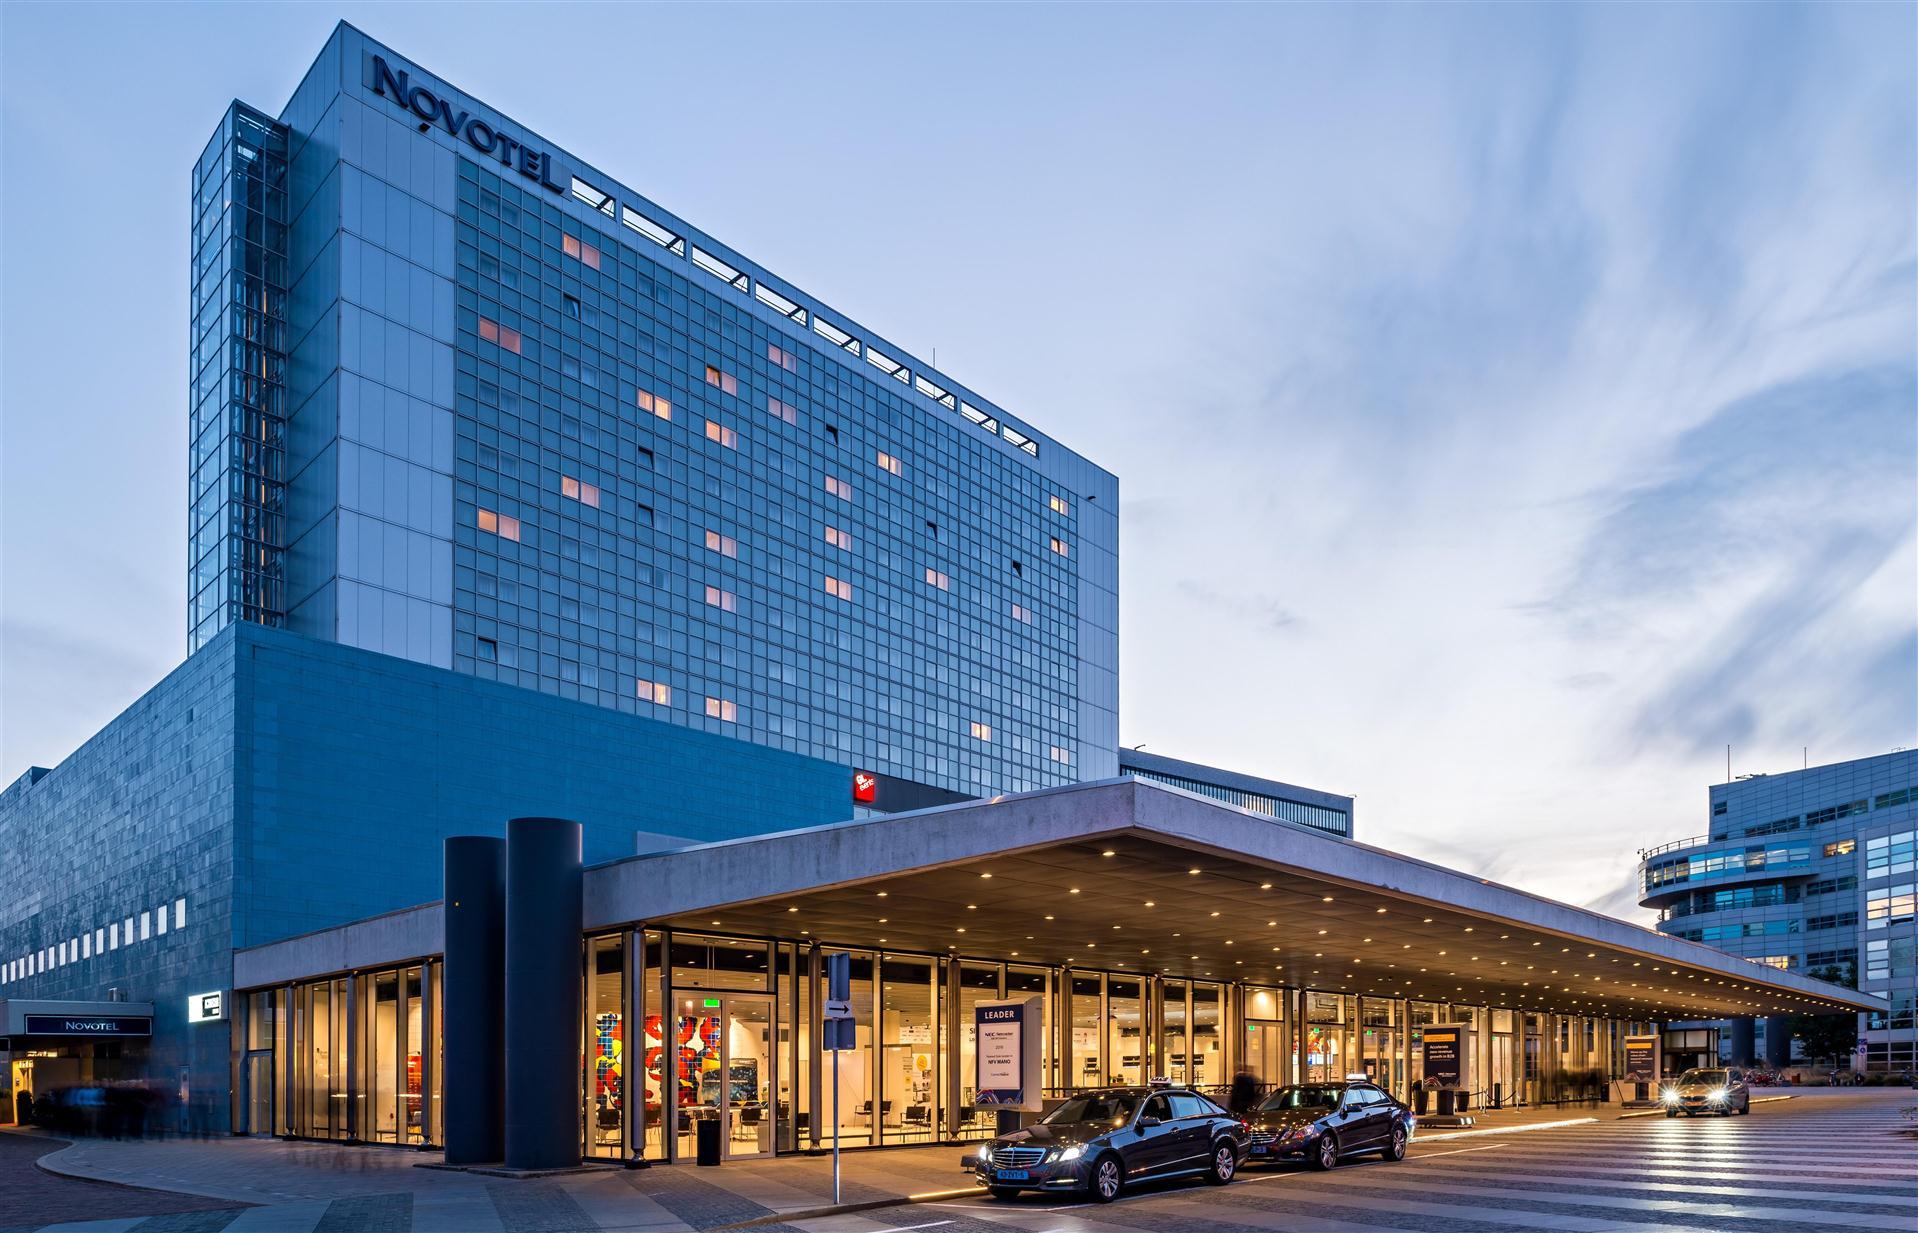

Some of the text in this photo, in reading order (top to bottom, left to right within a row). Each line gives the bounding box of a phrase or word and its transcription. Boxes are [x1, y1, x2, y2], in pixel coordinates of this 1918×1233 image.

[373, 54, 566, 195] NOVOTEL
[984, 1010, 1015, 1019] LEADER
[65, 1021, 120, 1031] NOVOTEL
